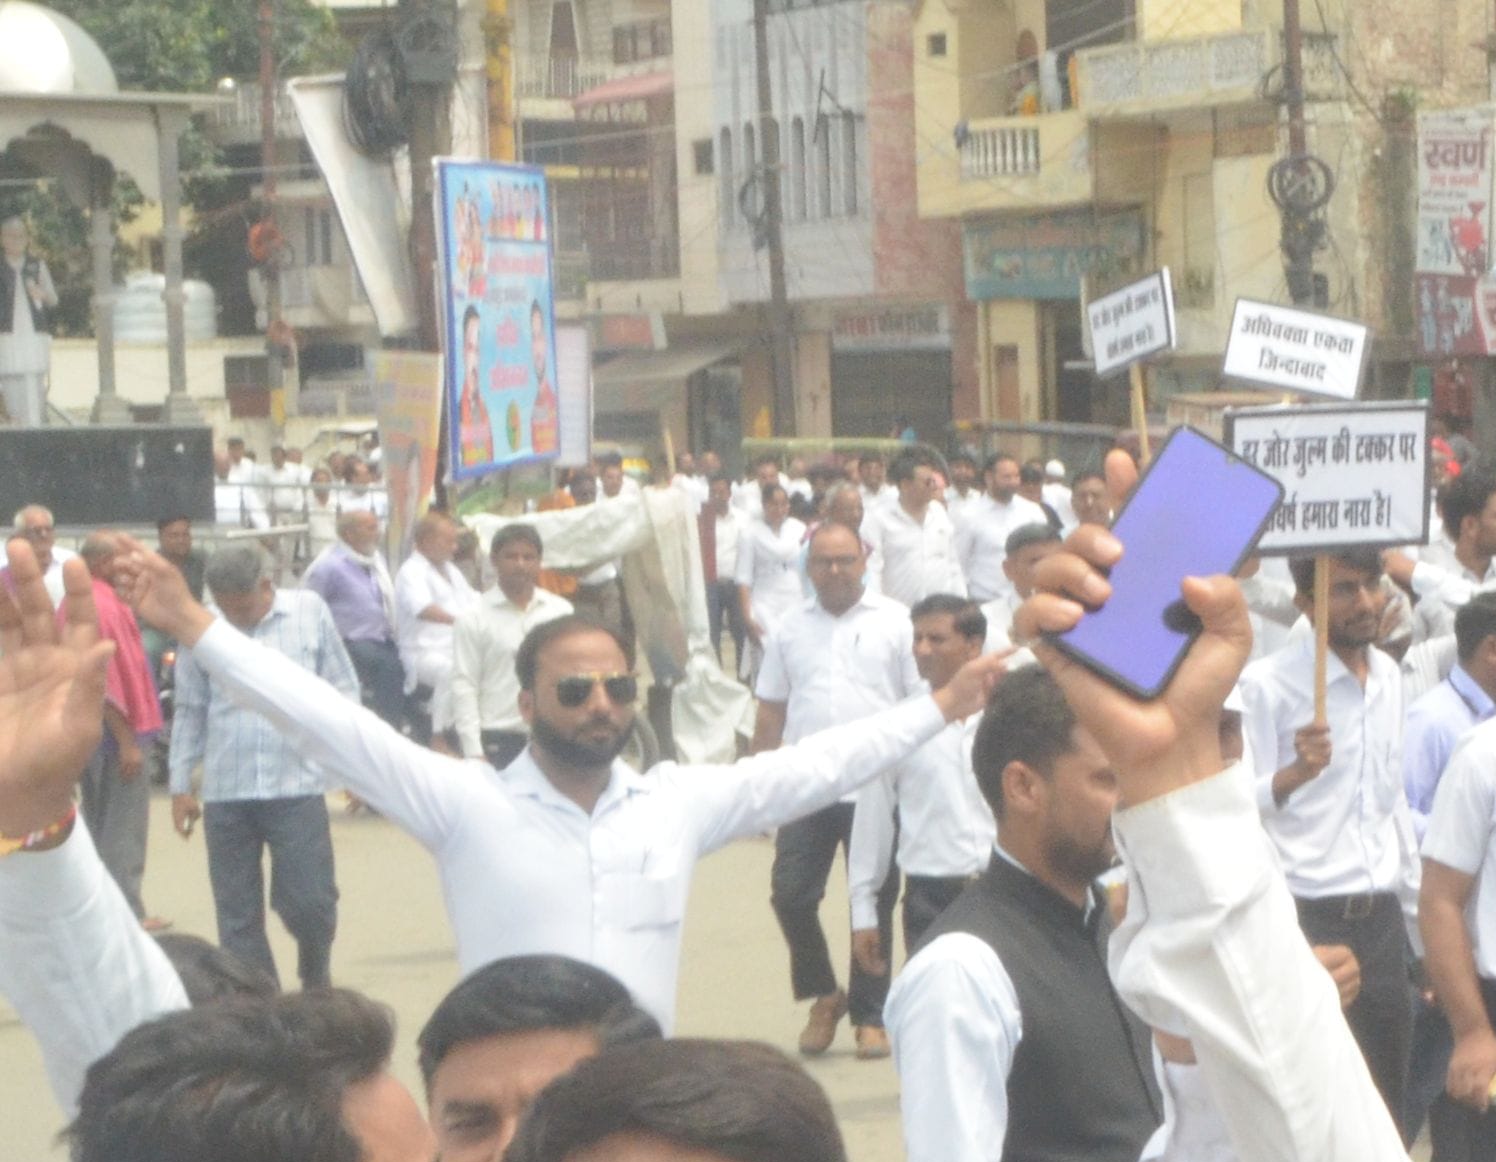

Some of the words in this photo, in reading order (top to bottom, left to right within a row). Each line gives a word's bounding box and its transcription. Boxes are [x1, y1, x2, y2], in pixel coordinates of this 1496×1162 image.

[1424, 126, 1494, 171] स्वर्ण
[1241, 314, 1309, 345] अधिवक्ता
[1313, 330, 1355, 355] एकता
[1258, 346, 1327, 382] जिन्दाबाद
[1264, 430, 1291, 467] जोर
[1293, 435, 1328, 478] जुल्म
[1332, 426, 1350, 463] की
[1355, 432, 1396, 462] टक्कर
[1399, 432, 1417, 462] पर
[1301, 500, 1339, 531] हमारा
[1344, 498, 1372, 528] नारा
